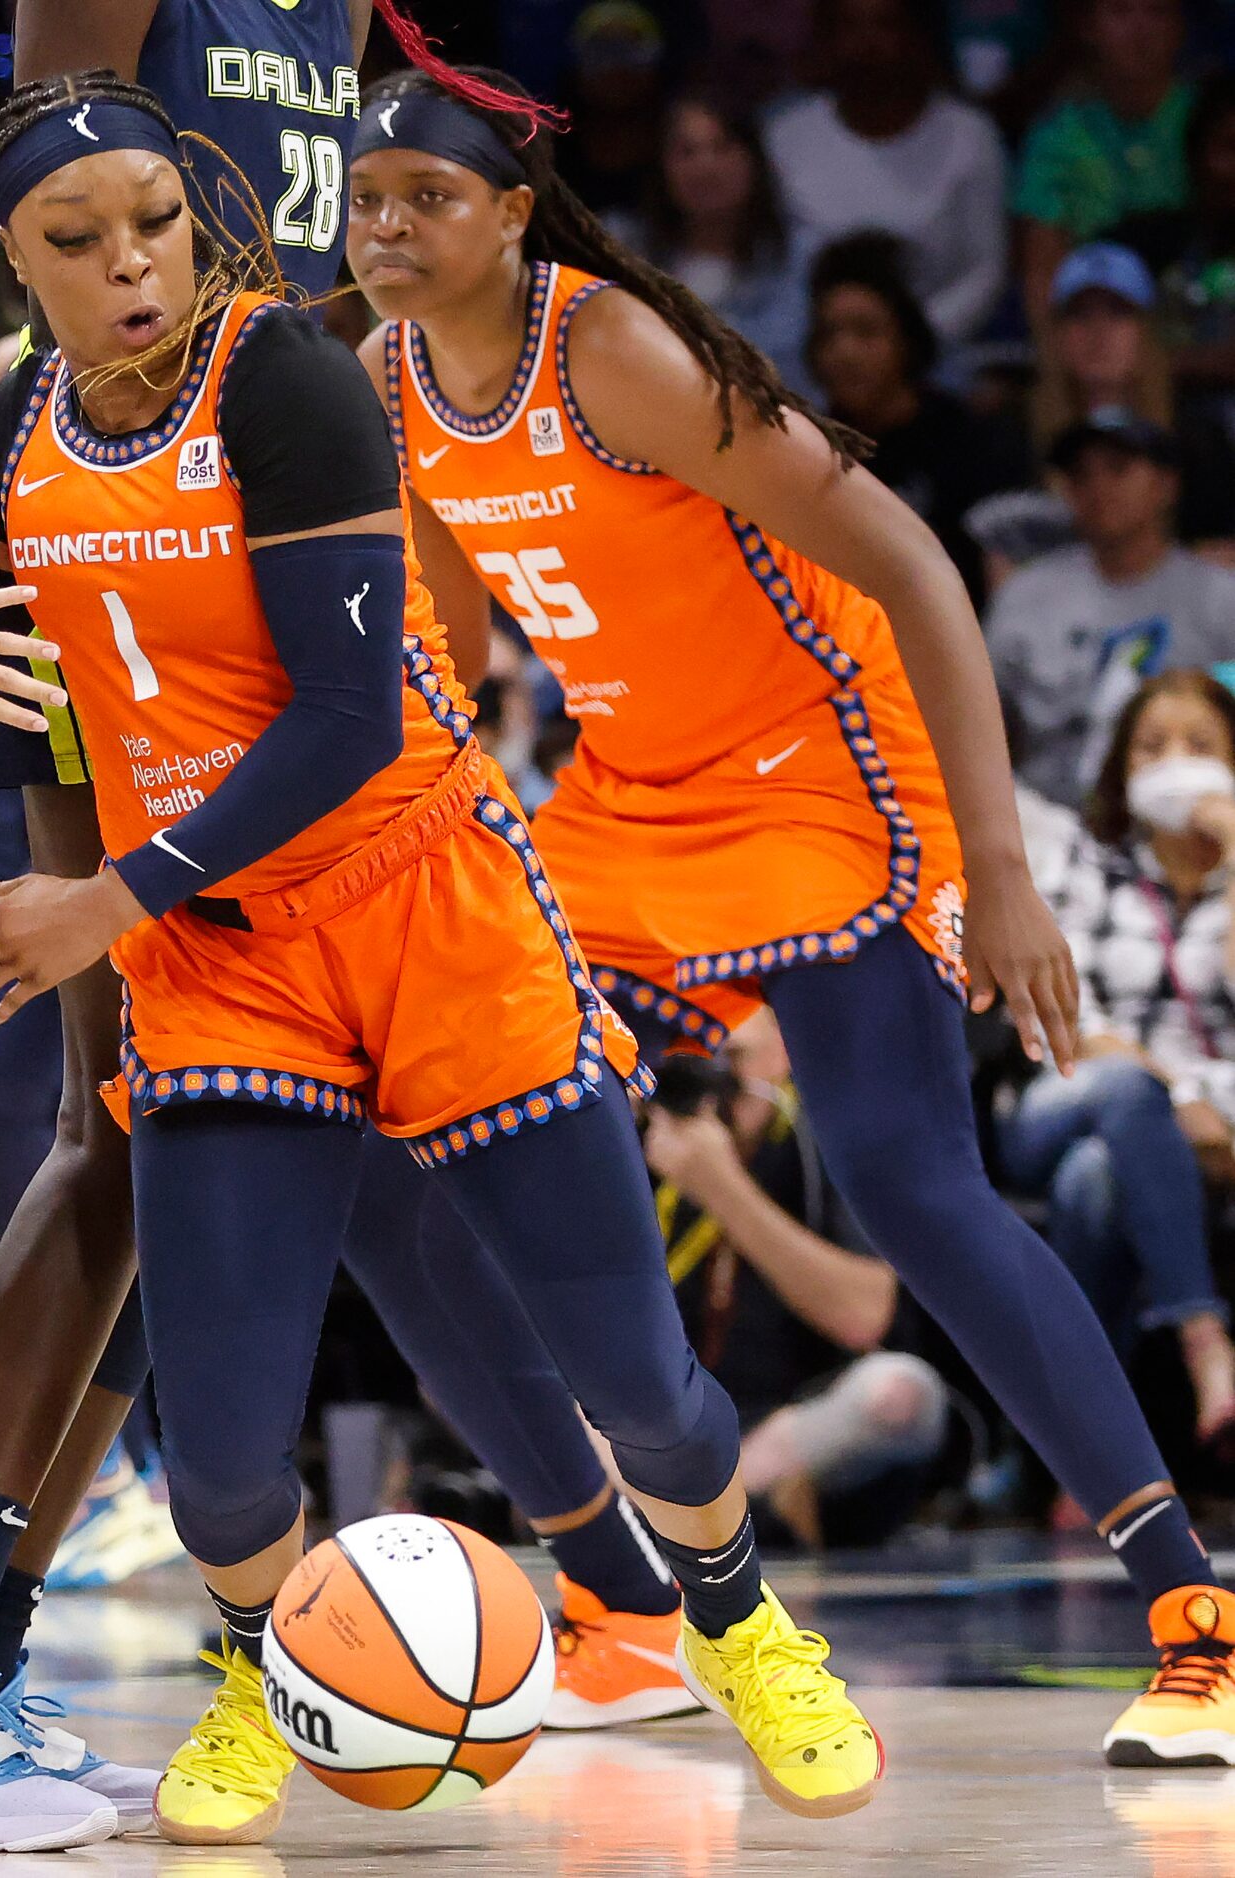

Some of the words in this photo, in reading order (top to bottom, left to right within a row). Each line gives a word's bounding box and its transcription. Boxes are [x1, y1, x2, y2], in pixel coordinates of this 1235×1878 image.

[272, 129, 342, 252] 28
[179, 463, 216, 480] Post
[431, 483, 577, 524] CONNECTICUT
[11, 524, 234, 569] CONNECTICUT
[474, 546, 600, 640] 35
[100, 590, 160, 702] 1
[119, 733, 152, 759] Yale
[131, 742, 244, 790] NewHaven
[139, 784, 205, 817] Health
